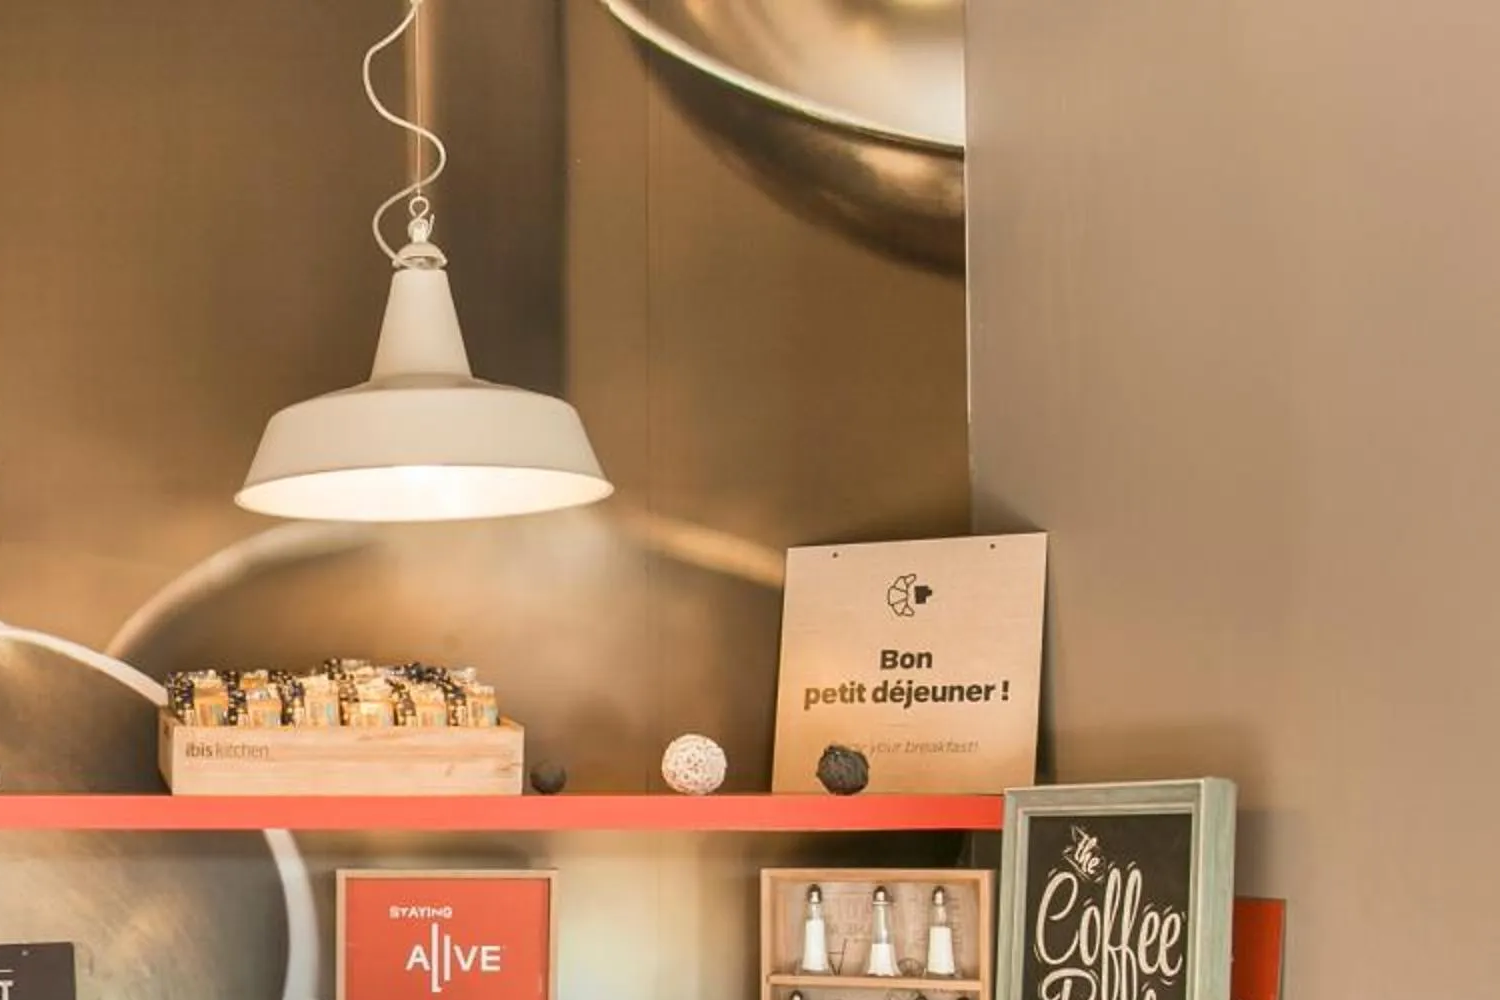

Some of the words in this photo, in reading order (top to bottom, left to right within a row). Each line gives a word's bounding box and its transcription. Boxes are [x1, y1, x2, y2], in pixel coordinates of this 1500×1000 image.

[880, 649, 933, 670] Bon
[804, 681, 866, 710] petit
[871, 679, 995, 709] déjeuner
[185, 741, 213, 758] ibis
[215, 741, 270, 759] kitchen
[1073, 836, 1101, 876] the
[389, 905, 453, 919] STAYING
[405, 922, 501, 993] ALIVE
